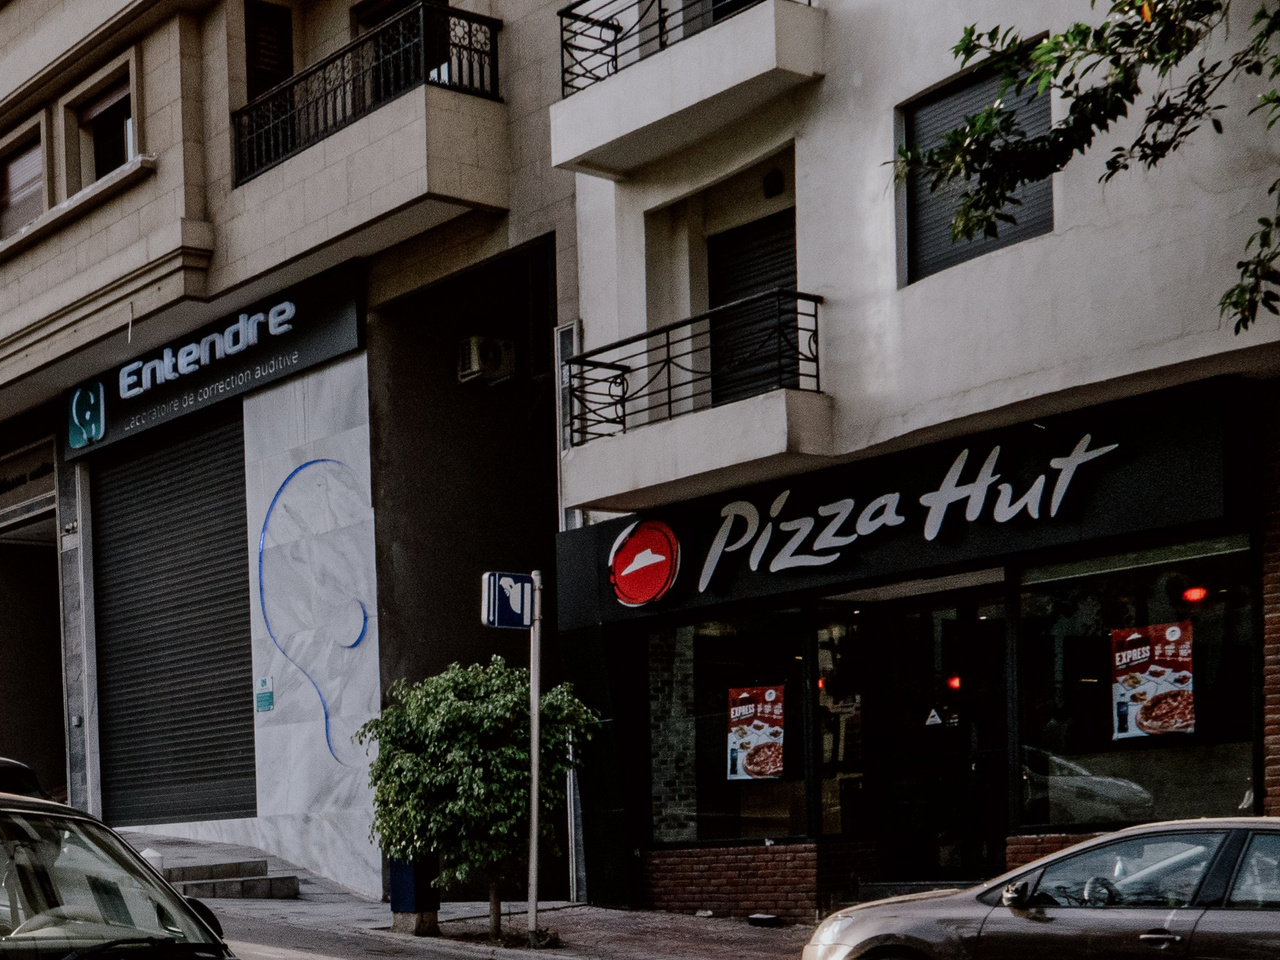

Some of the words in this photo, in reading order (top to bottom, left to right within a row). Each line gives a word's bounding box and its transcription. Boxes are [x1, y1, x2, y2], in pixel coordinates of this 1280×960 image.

[120, 301, 296, 399] Entendre
[181, 391, 195, 408] de
[197, 369, 252, 402] correction
[254, 350, 299, 379] auditive
[697, 489, 906, 593] Pizza
[919, 433, 1119, 542] Hut
[1115, 645, 1151, 667] EXPRESS
[730, 703, 756, 720] EXPRESS
